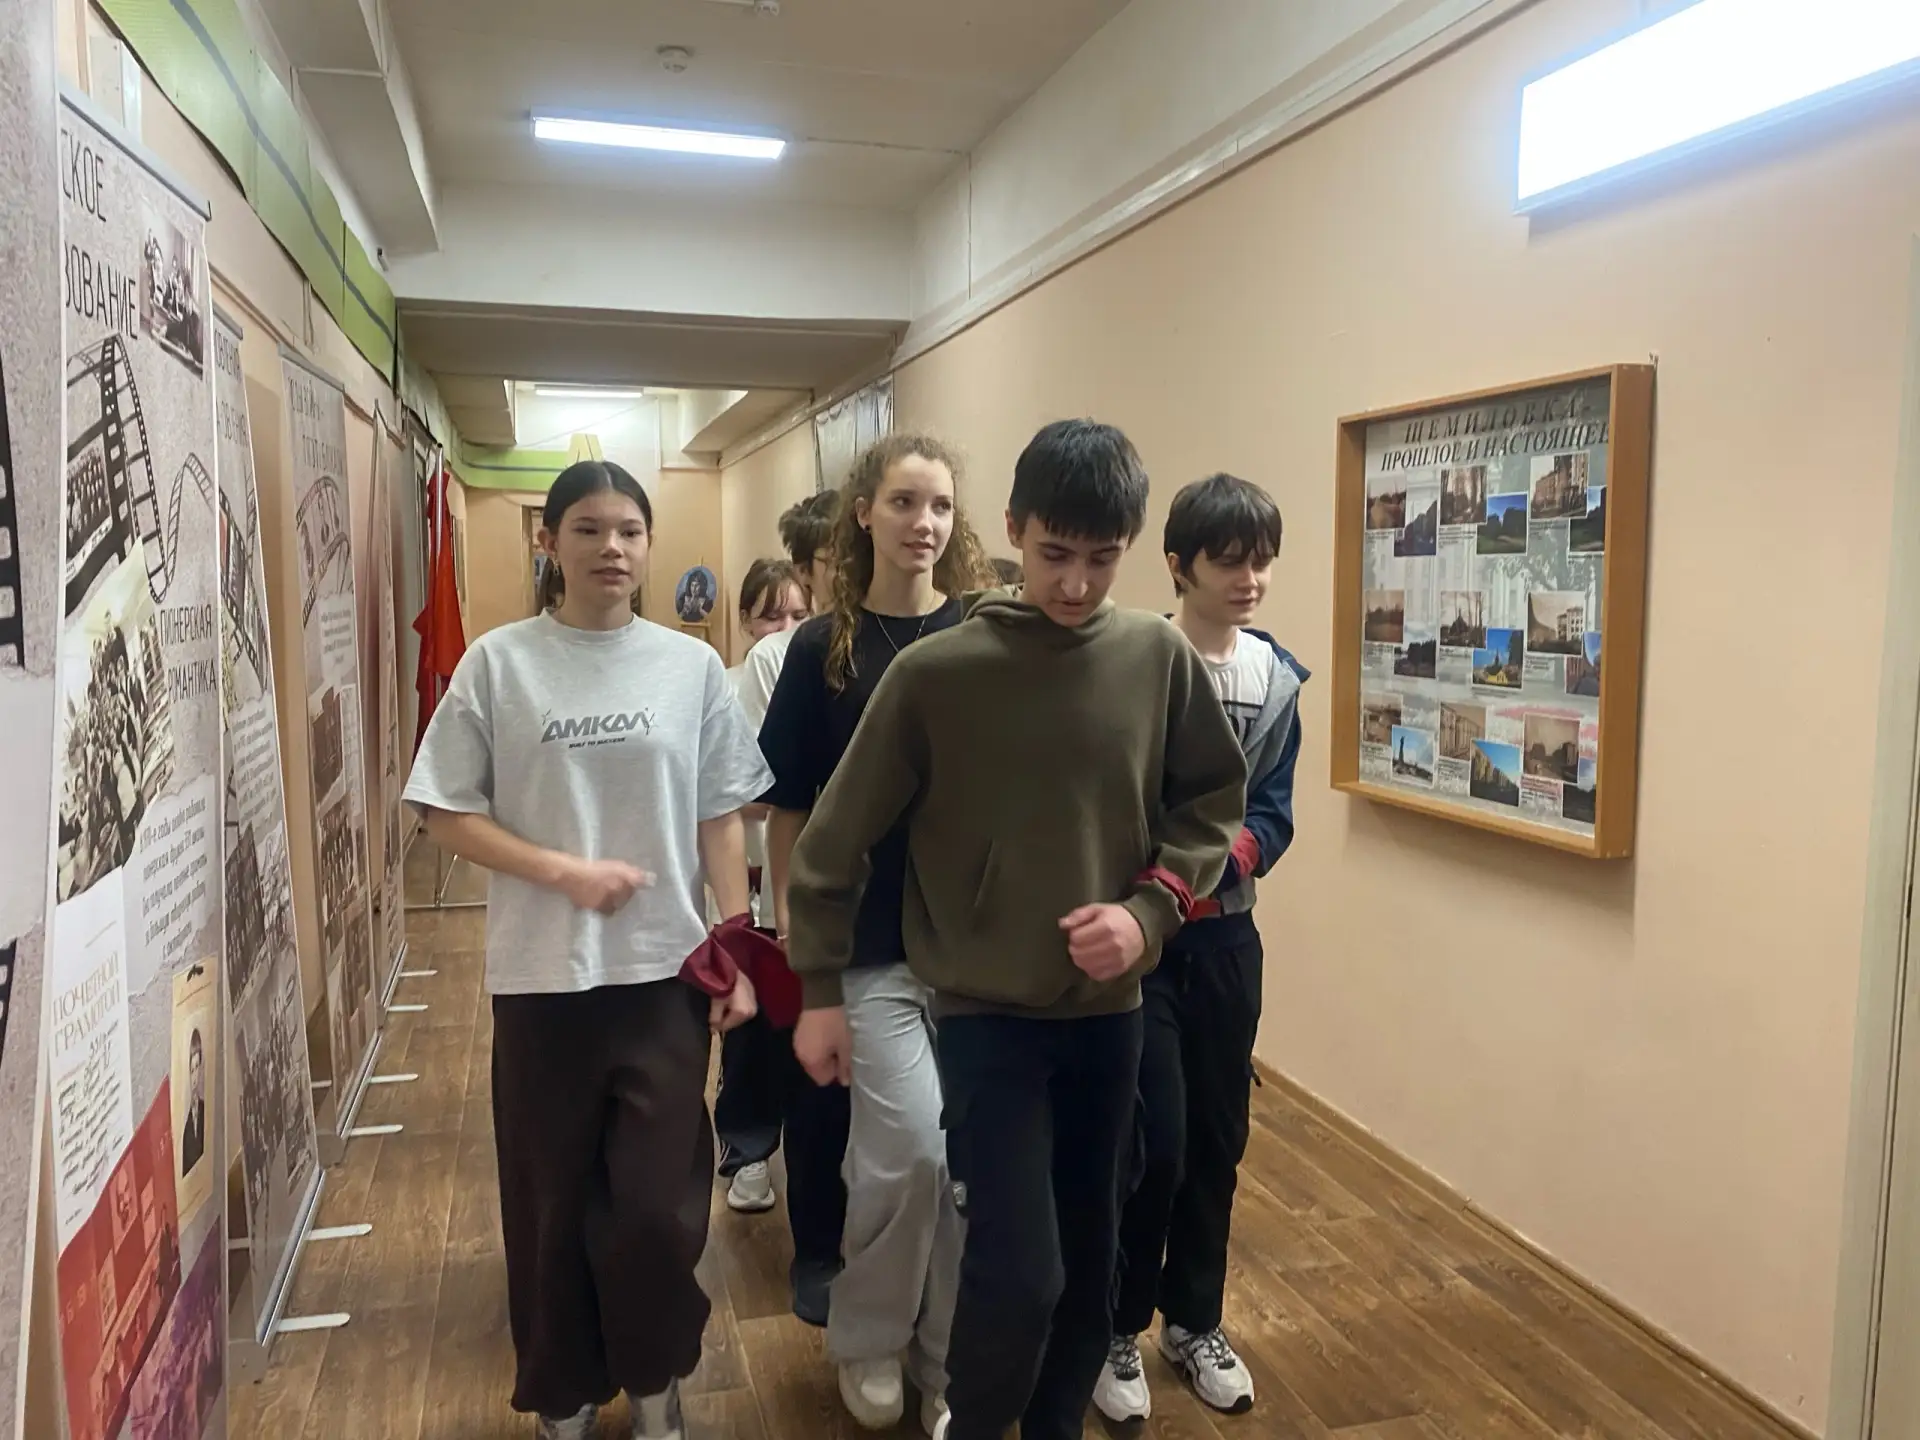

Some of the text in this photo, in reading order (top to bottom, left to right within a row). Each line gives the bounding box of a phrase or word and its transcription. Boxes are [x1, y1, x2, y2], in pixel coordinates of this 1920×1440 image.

[1380, 439, 1462, 472] ПРОШЛОЕ
[1465, 437, 1481, 461] И
[160, 603, 212, 647] ПИОНЕРСКАЯ
[167, 657, 217, 704] РОМАНТИКА
